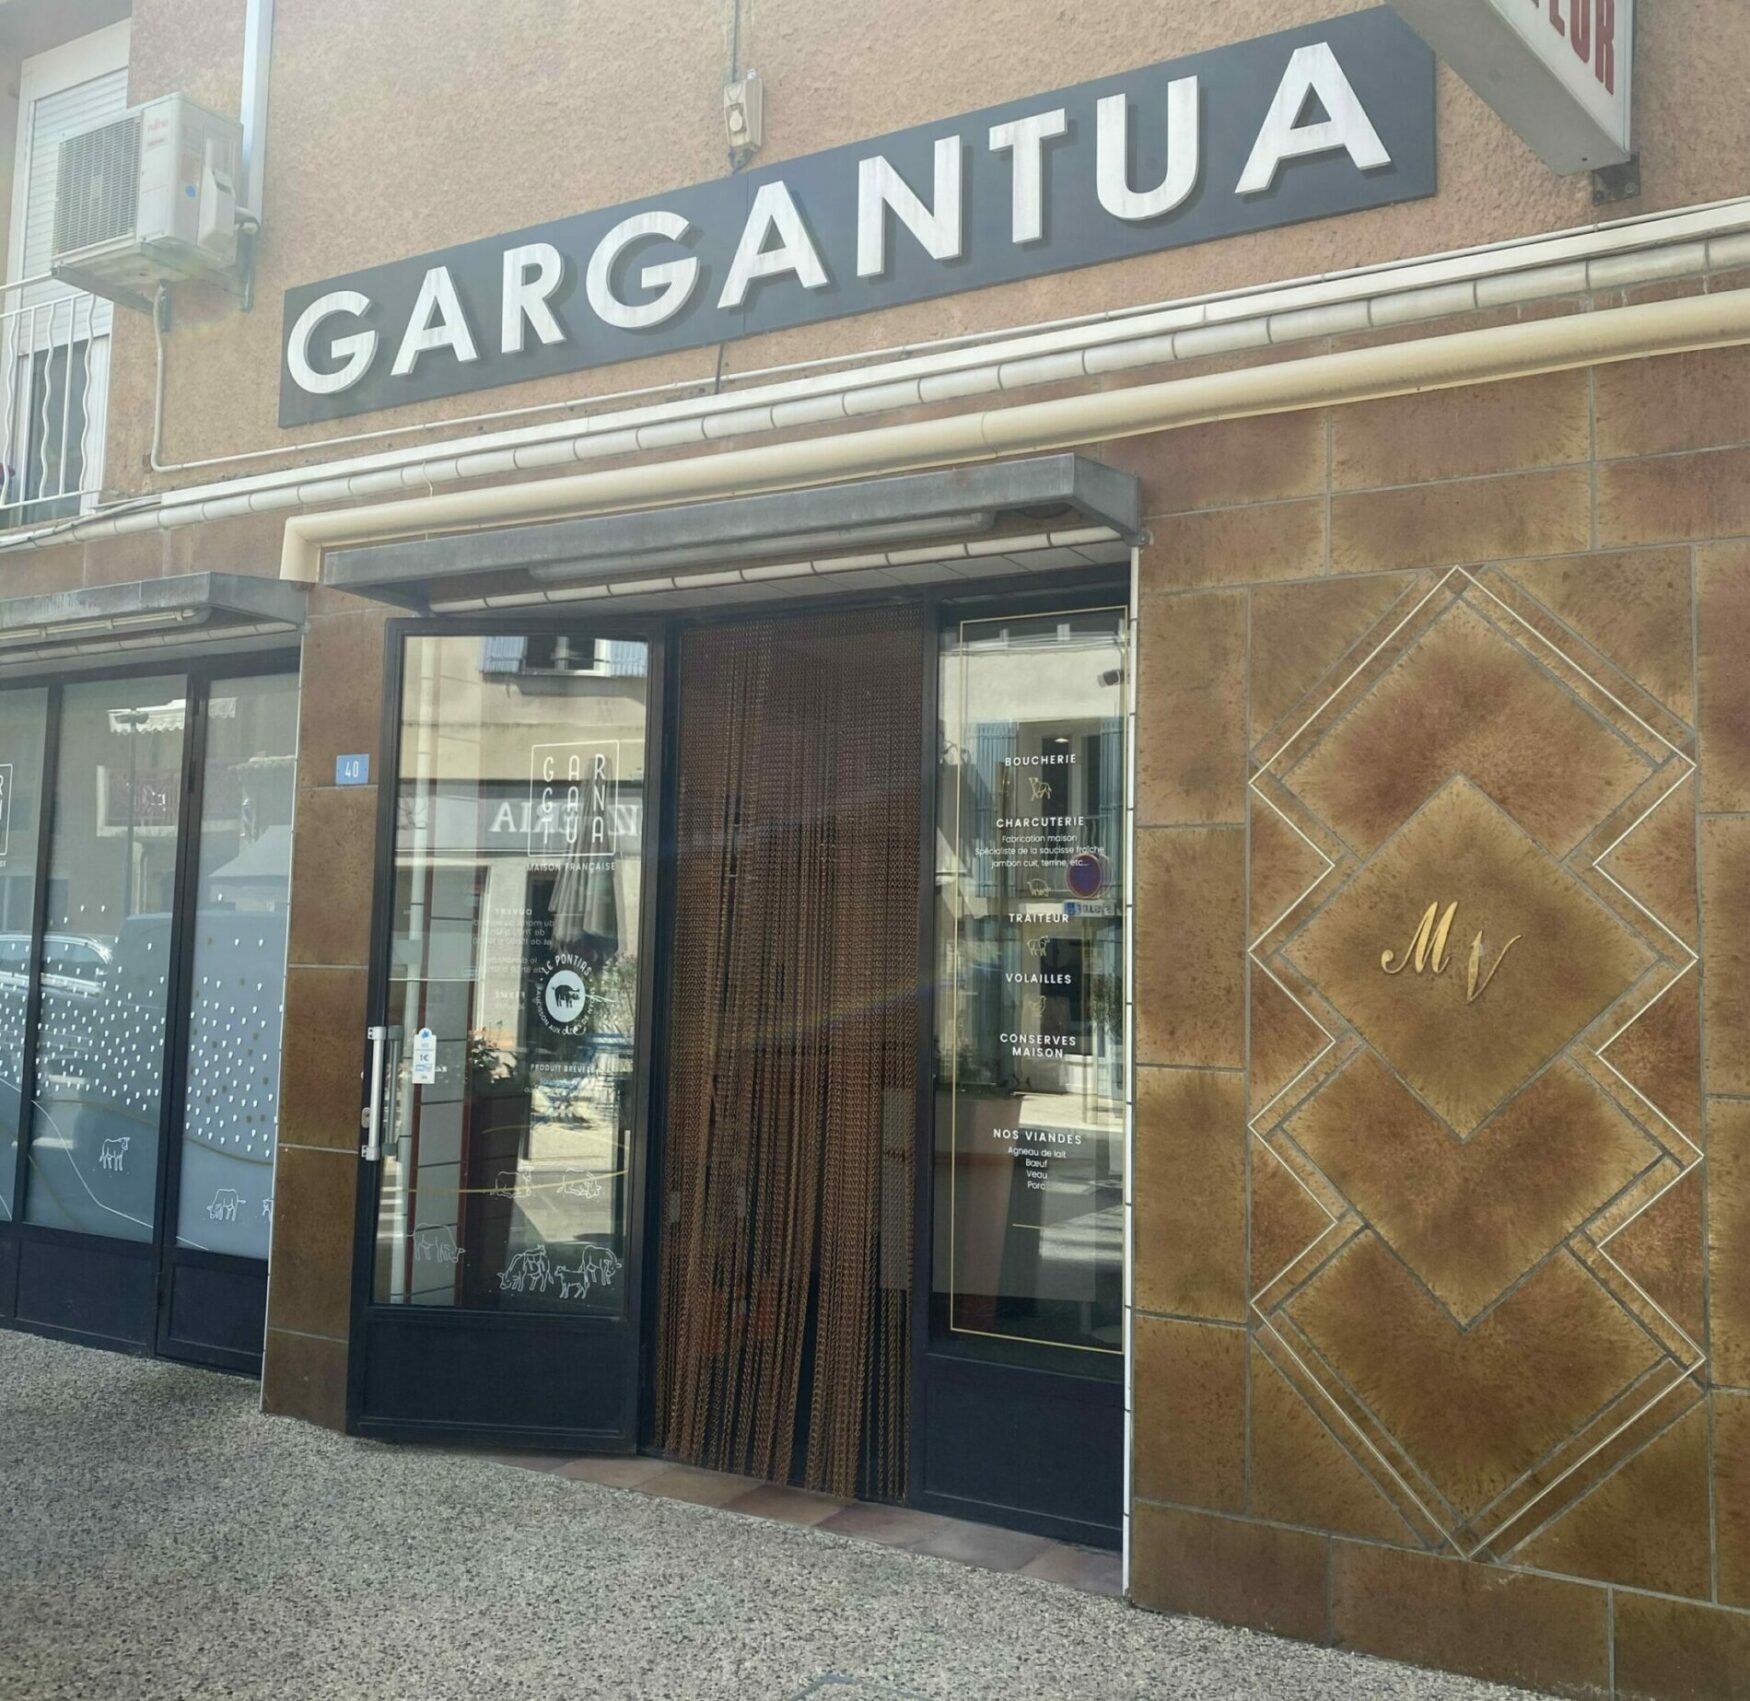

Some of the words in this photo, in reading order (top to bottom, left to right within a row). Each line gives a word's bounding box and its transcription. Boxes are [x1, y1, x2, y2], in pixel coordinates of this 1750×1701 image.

[286, 42, 1392, 394] GARGANTUA
[1004, 753, 1077, 767] BOUCHERIE
[344, 760, 359, 778] 40
[996, 816, 1086, 828] CHARCUTERIE
[1001, 835, 1046, 843] Fabrication
[1047, 834, 1078, 842] maison
[565, 862, 617, 874] FRANÇAISE
[991, 860, 1022, 870] jambon
[1008, 913, 1070, 923] TRAITEUR
[541, 960, 554, 975] LE
[554, 953, 593, 977] PONTIAS
[1005, 972, 1072, 984] VOLAILLES
[999, 1033, 1077, 1046] CONSERVES
[1011, 1047, 1064, 1058] MAISON
[530, 1063, 561, 1072] PRODUIT
[993, 1128, 1019, 1140] NOS
[1025, 1130, 1082, 1145] VIANDES
[1008, 1146, 1039, 1157] Agneau
[1041, 1148, 1052, 1157] de
[1053, 1150, 1067, 1158] lait
[1025, 1158, 1048, 1168] Bœuf
[1026, 1169, 1048, 1179] Veau
[1027, 1180, 1046, 1190] Porc
